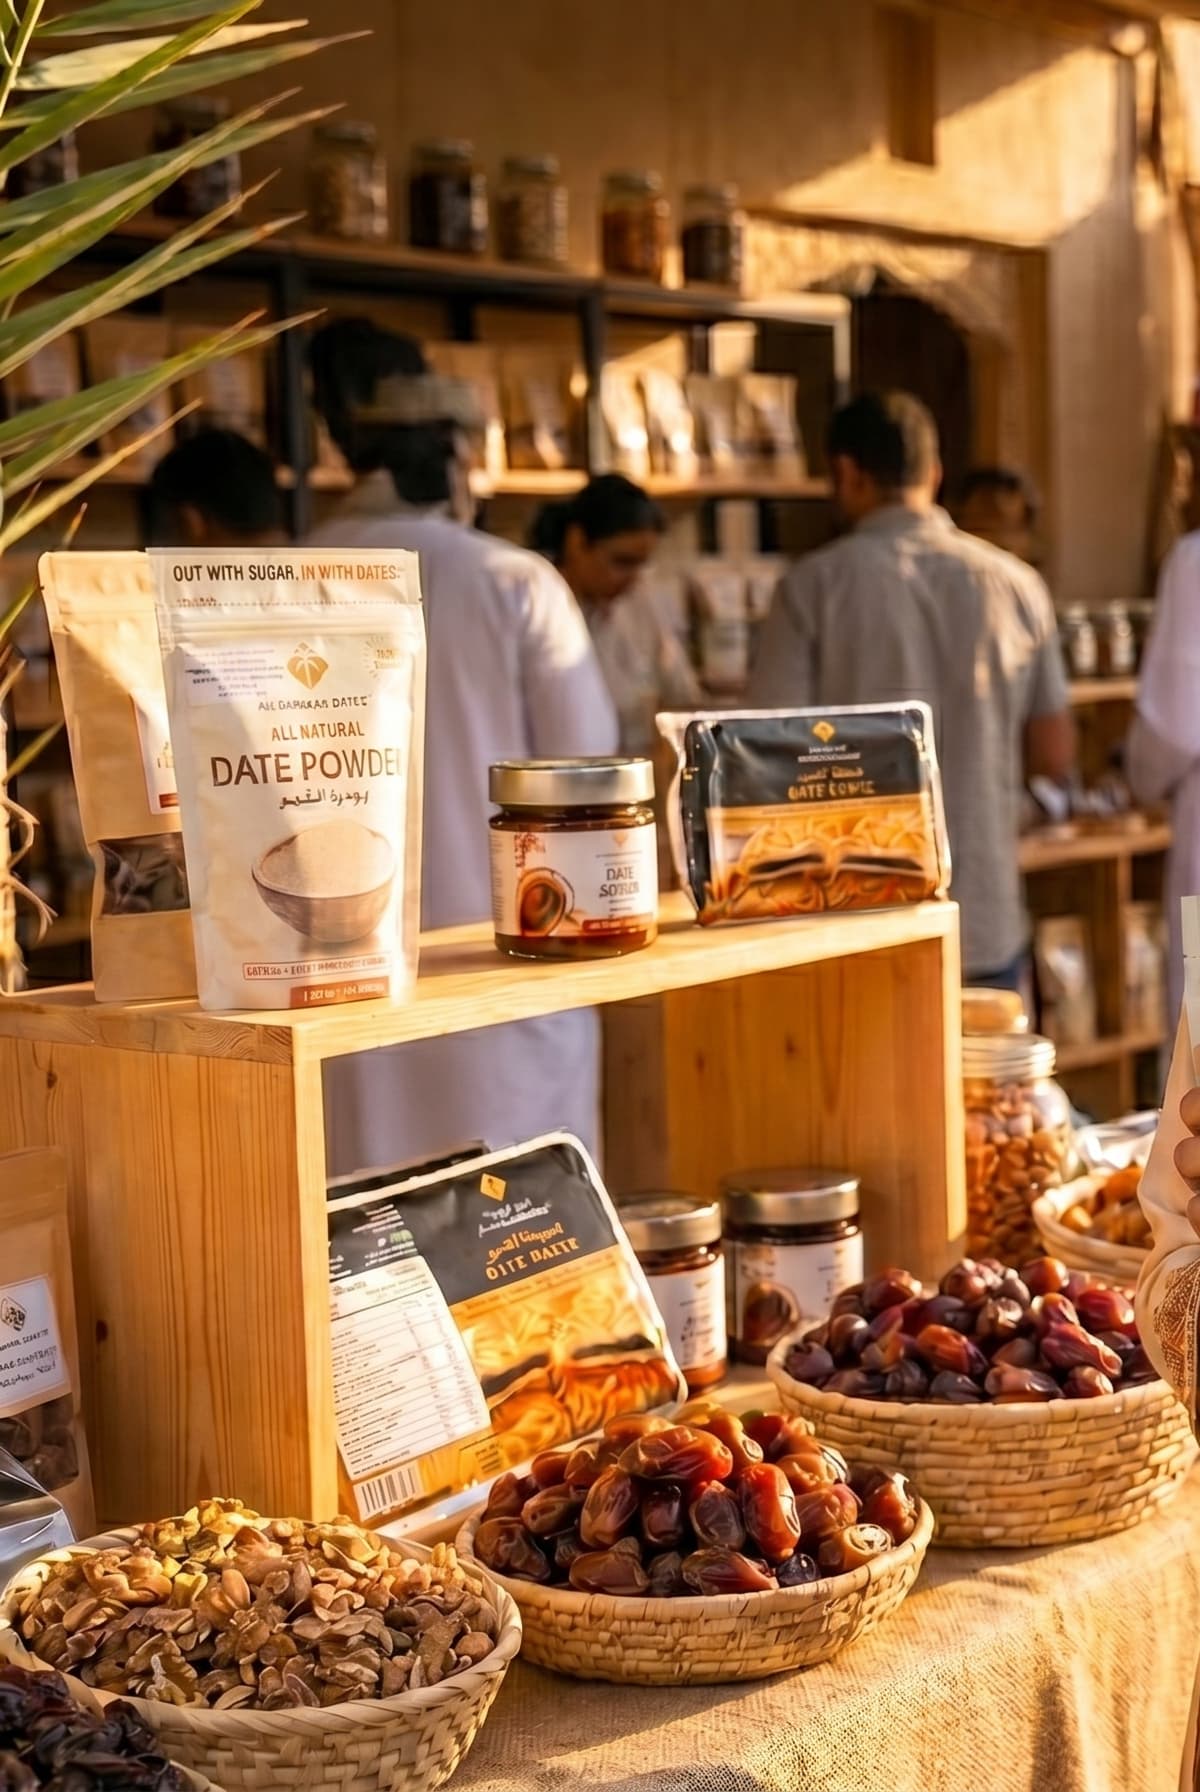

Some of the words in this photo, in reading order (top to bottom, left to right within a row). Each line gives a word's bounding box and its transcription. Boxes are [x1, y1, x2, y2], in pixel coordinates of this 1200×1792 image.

[173, 565, 202, 582] OUT
[207, 565, 244, 581] WITH
[301, 564, 316, 580] IN
[318, 564, 353, 580] WITH
[271, 725, 298, 742] ALL
[299, 721, 365, 740] NATURAL
[210, 753, 293, 787] DATE
